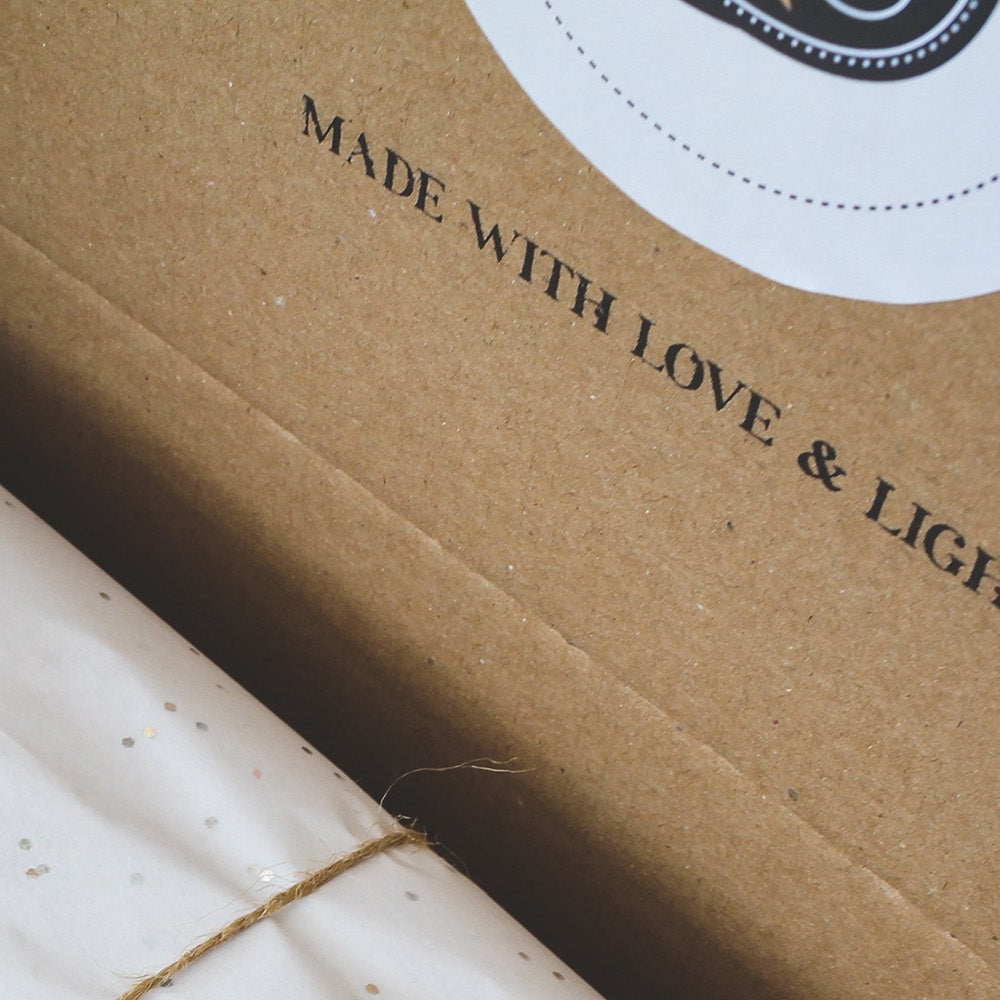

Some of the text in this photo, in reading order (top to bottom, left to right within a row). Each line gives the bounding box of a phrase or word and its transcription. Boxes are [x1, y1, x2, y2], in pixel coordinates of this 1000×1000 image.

[302, 94, 446, 223] MADE
[466, 199, 617, 335] WITH
[630, 315, 782, 447] LOVE
[797, 440, 847, 492] &
